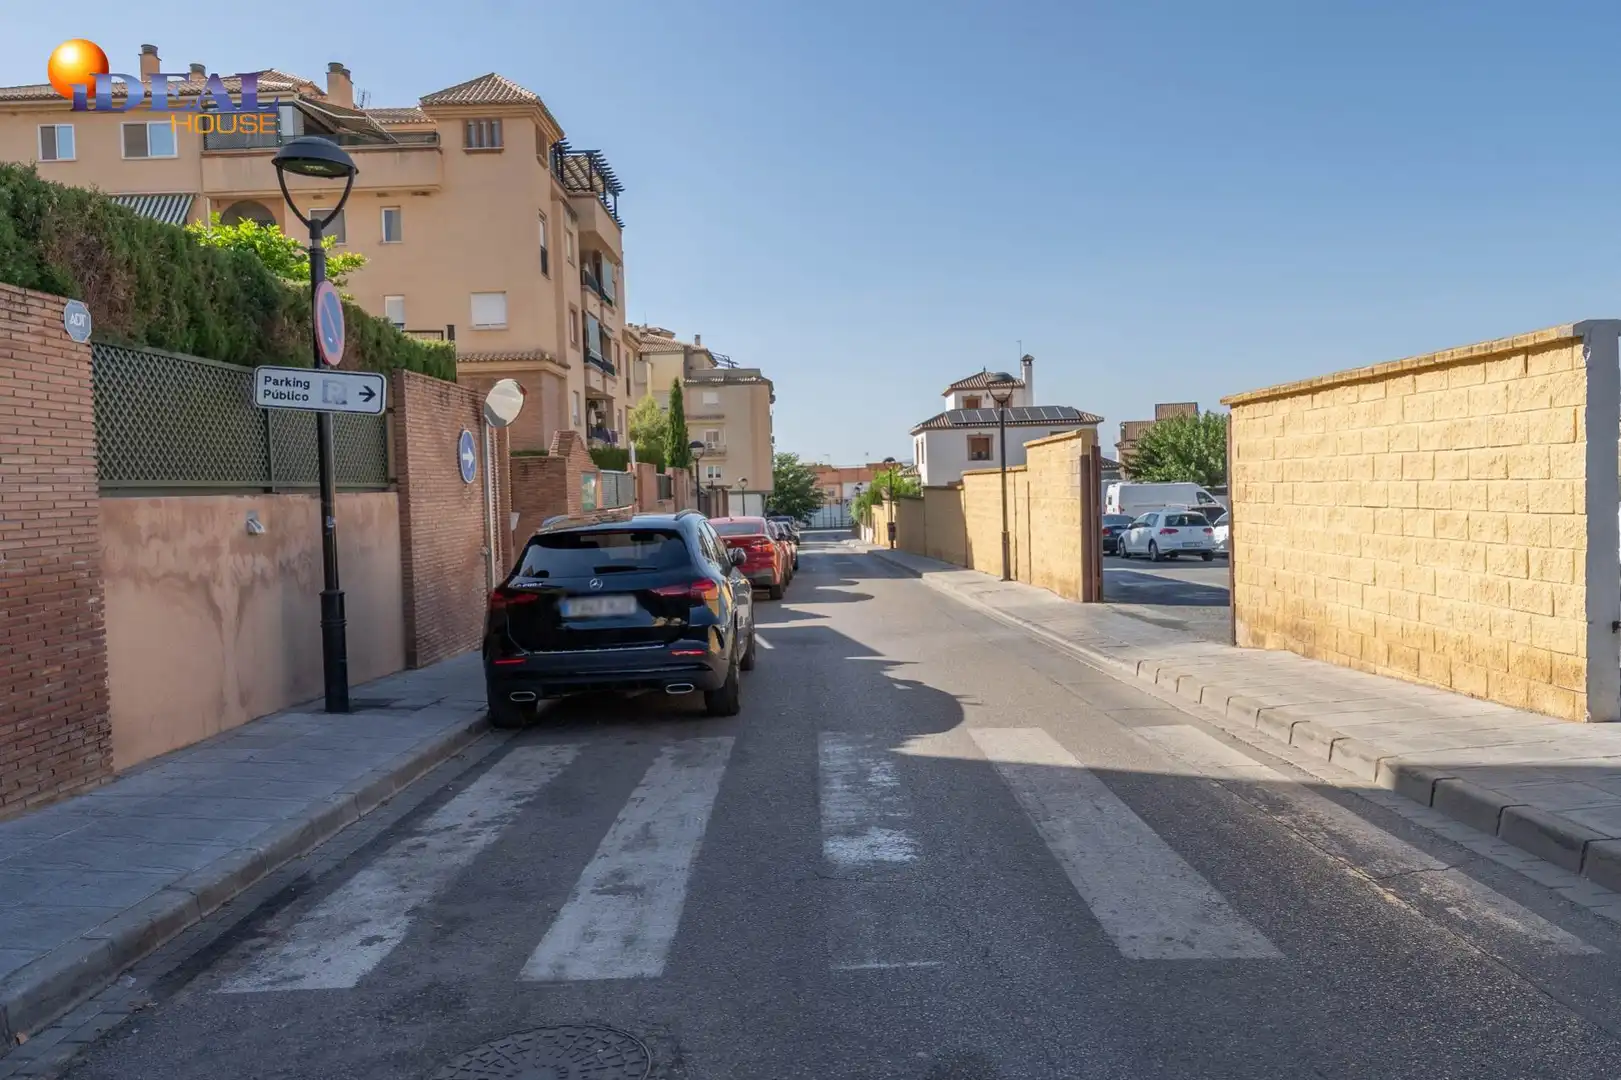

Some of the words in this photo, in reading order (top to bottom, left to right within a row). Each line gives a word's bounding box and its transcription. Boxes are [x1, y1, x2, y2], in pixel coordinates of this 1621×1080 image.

[70, 312, 86, 328] ADT
[264, 375, 310, 390] Parking
[263, 389, 309, 402] Público
